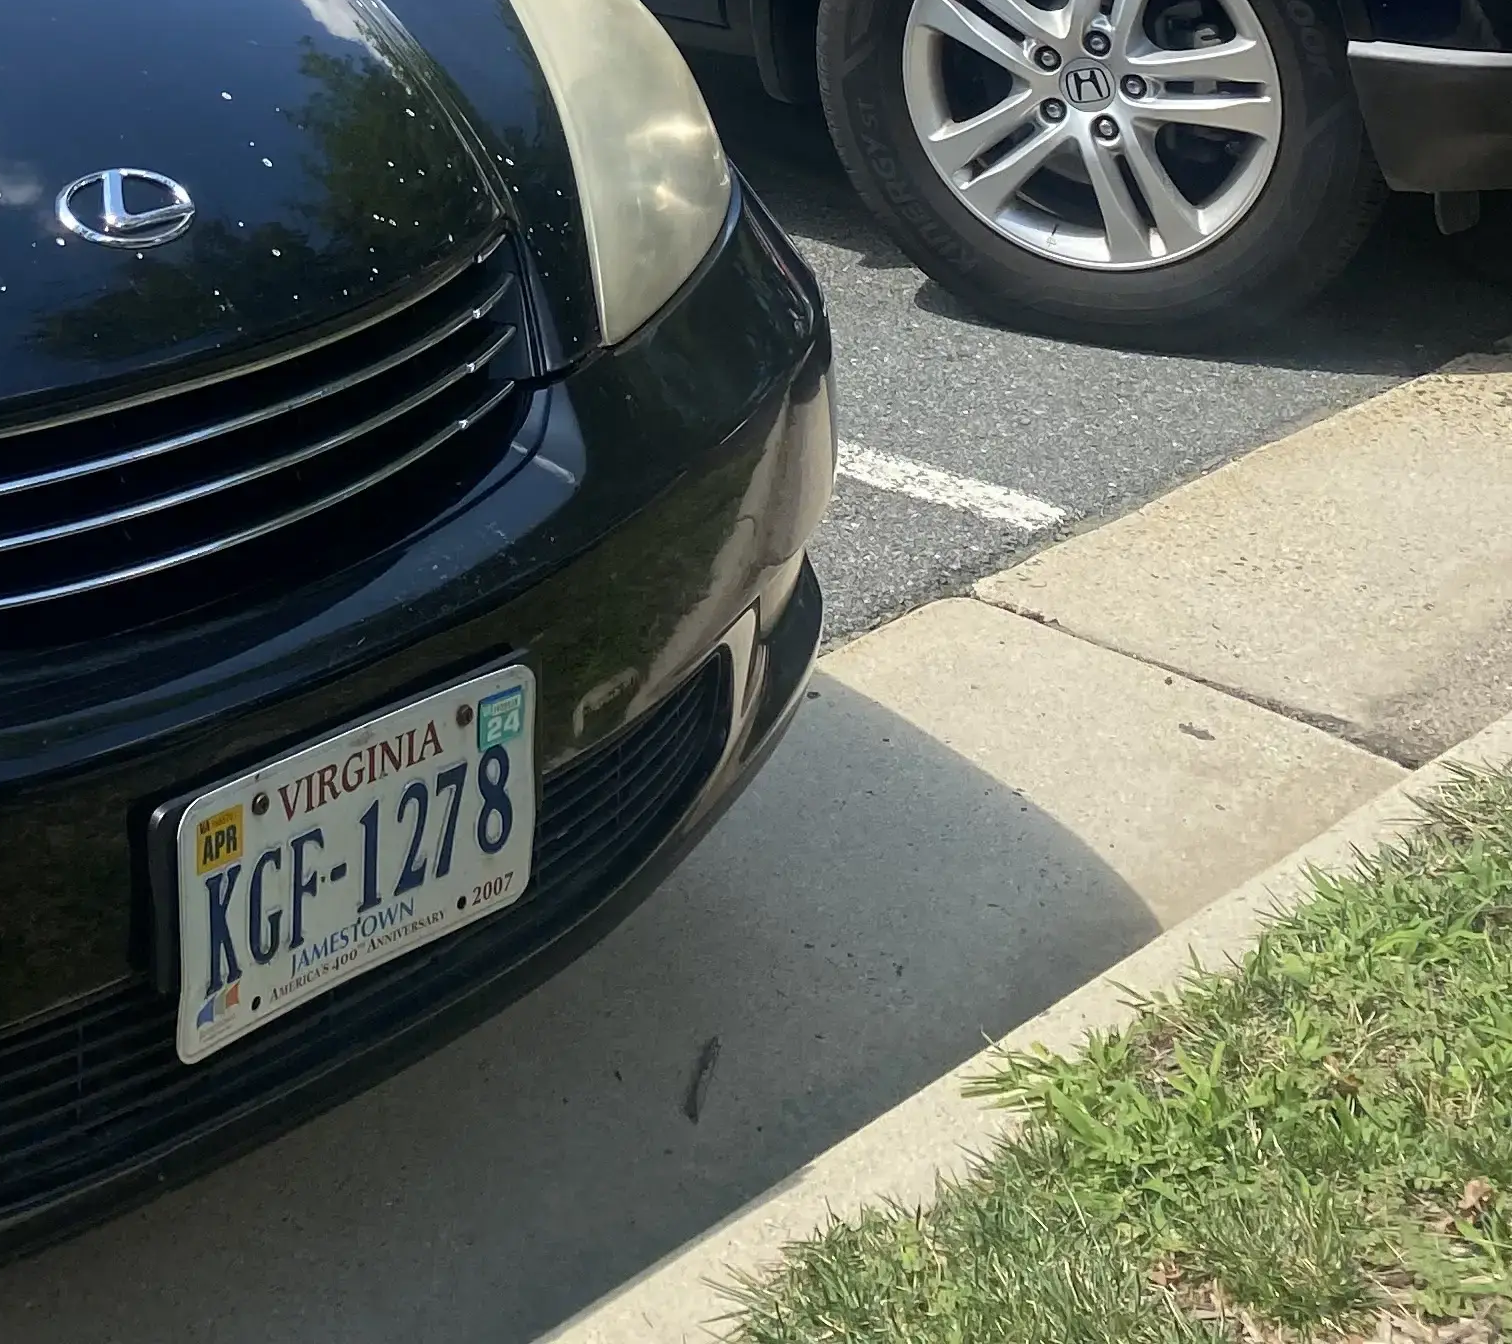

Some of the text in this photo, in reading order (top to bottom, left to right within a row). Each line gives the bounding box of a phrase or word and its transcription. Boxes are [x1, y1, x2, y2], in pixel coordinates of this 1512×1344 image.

[487, 708, 520, 742] 24
[277, 719, 444, 822] VIRGINIA
[203, 823, 238, 865] APR
[204, 745, 514, 997] KGF-1278
[472, 871, 514, 908] 2007
[269, 962, 330, 1005] AMERICA'S
[366, 909, 446, 954] ANNIVERSARY
[291, 897, 414, 980] JAMESTOWN
